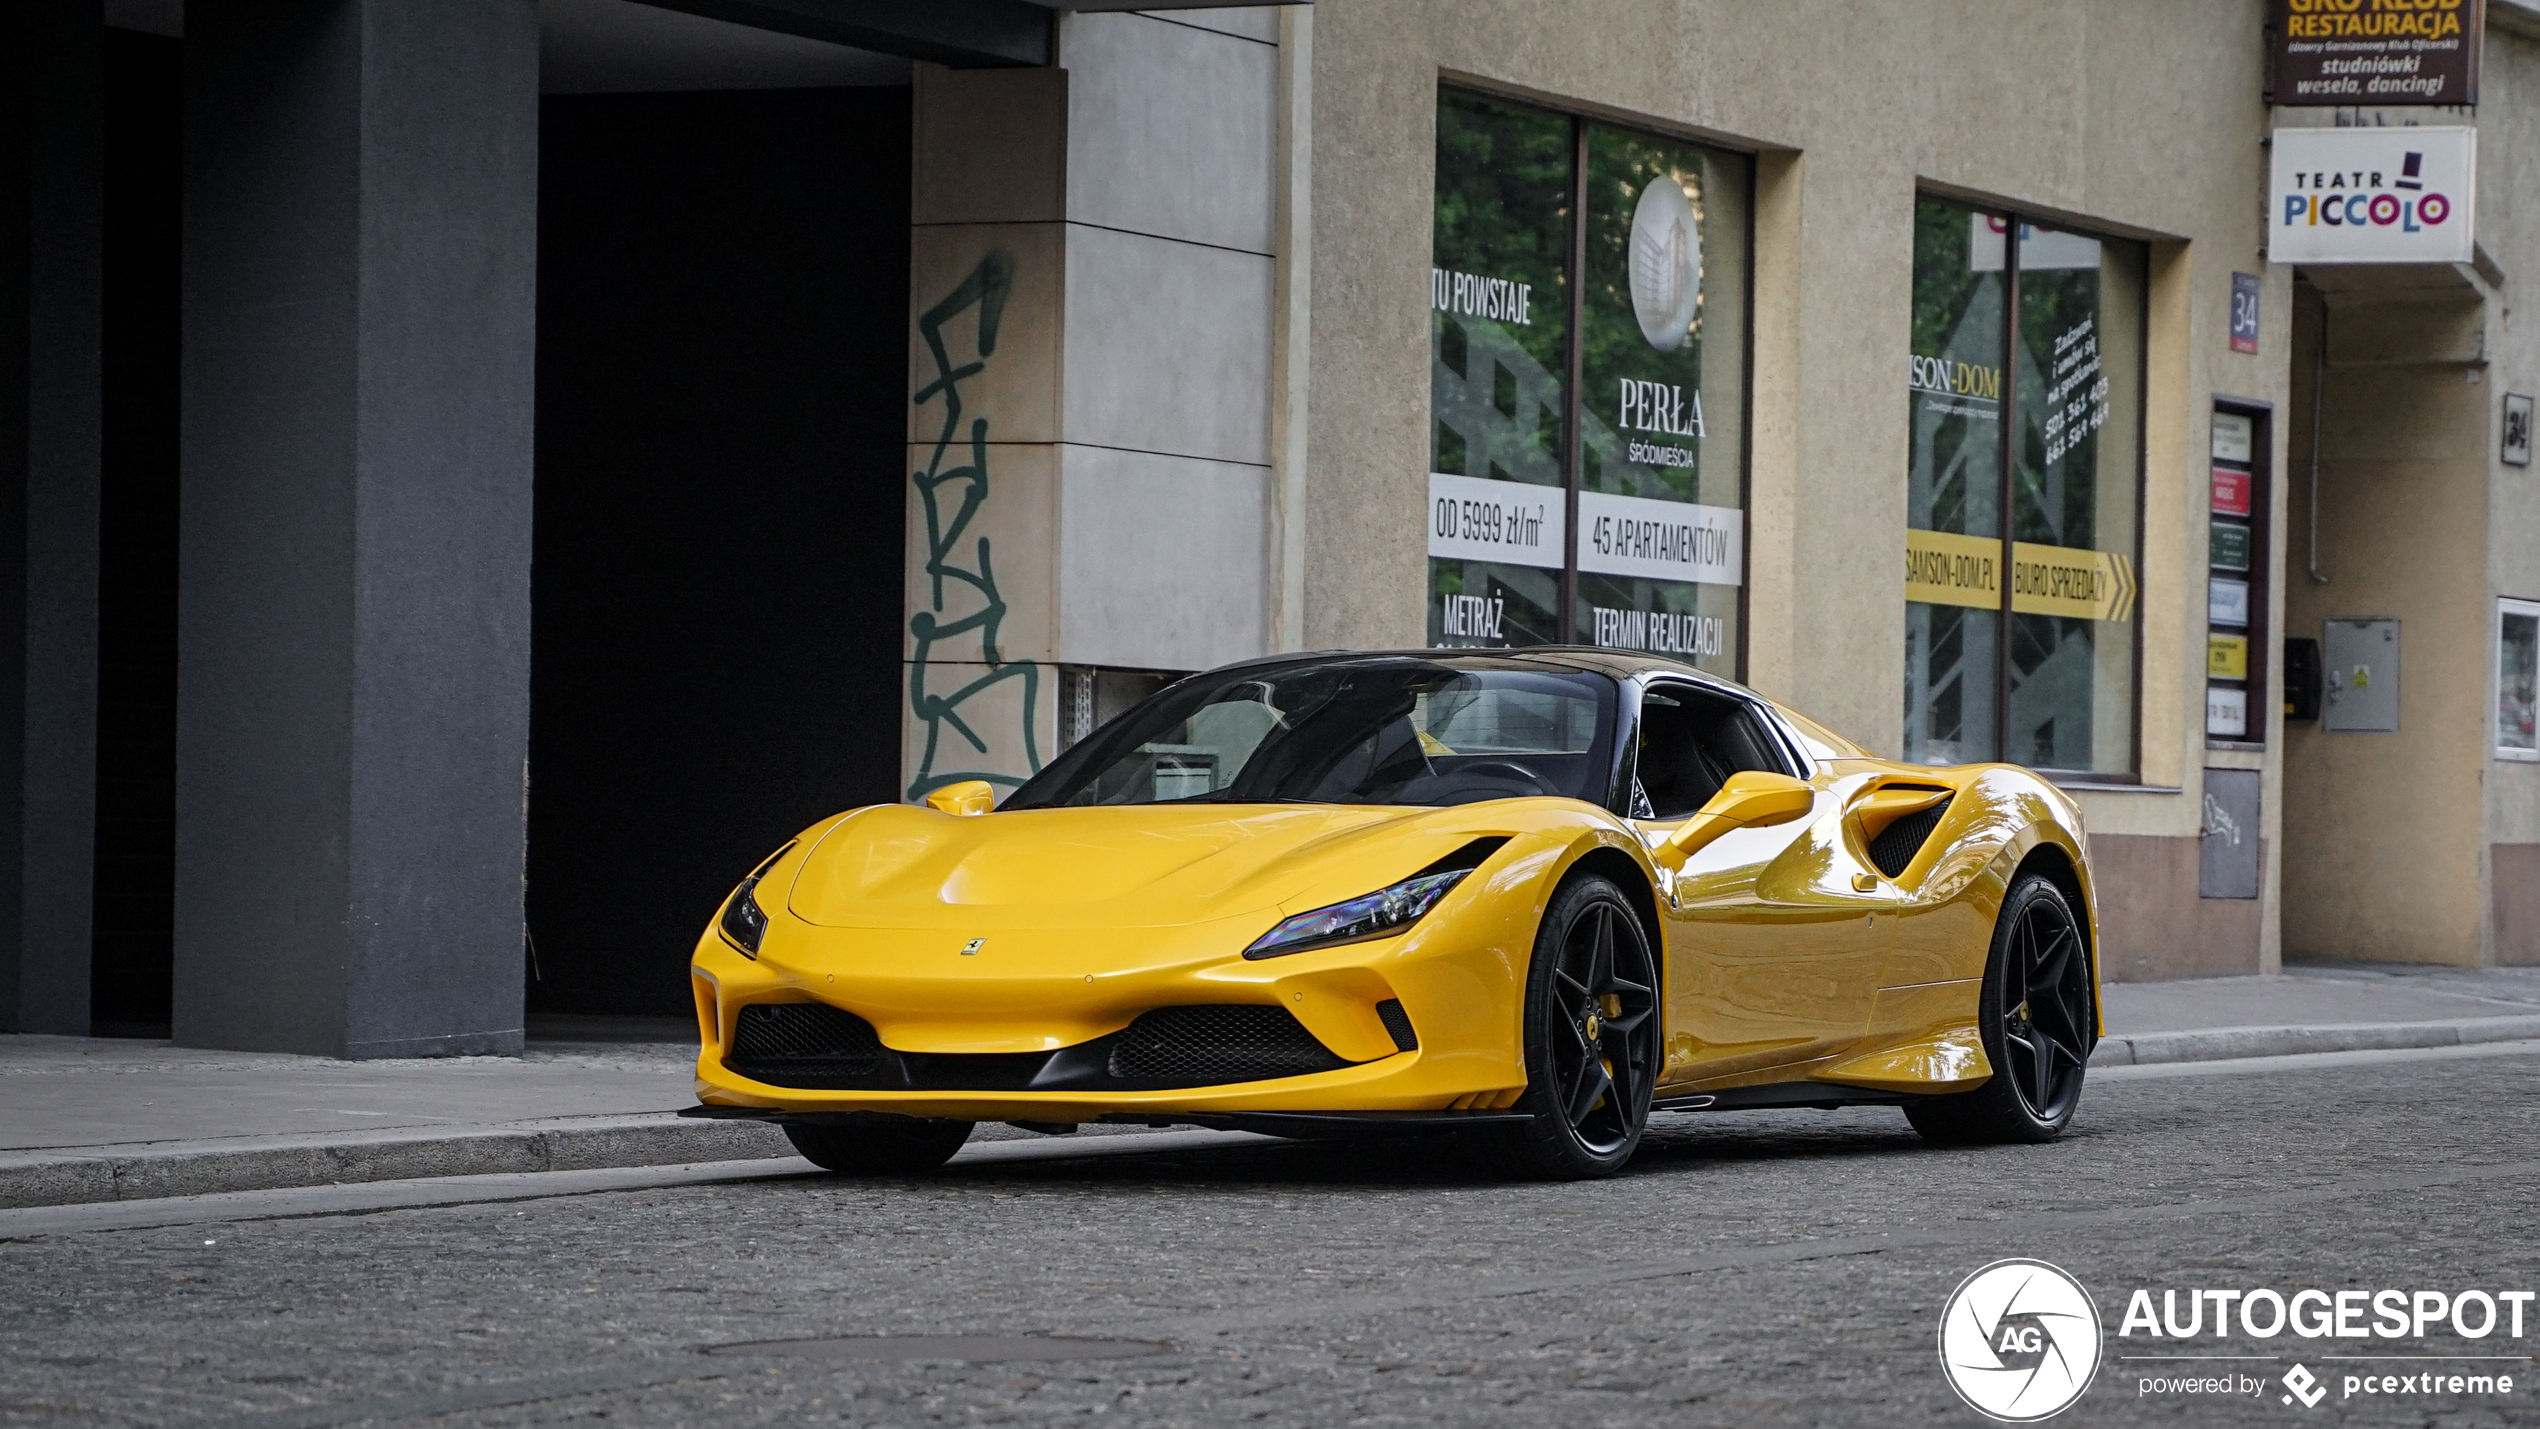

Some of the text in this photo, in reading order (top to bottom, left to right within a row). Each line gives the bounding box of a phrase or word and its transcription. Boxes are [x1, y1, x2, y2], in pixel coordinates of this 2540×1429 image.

[2288, 12, 2461, 39] RESTAURACJA
[2388, 39, 2410, 51] Klub
[2297, 74, 2445, 96] wesela, dancingi
[2321, 55, 2421, 74] studniówki
[2295, 172, 2383, 189] TEATR
[2284, 193, 2450, 233] PICCOLO
[1432, 268, 1531, 325] TU POWSTAJE
[2234, 292, 2256, 334] 34
[1620, 378, 1706, 438] PERŁA
[1629, 439, 1694, 468] ŚRÓDMIEŚCIA
[1437, 497, 1457, 539] OD
[1463, 500, 1502, 543] 5999
[1593, 516, 1728, 567] 45 APARTAMENTÓW
[1906, 549, 1995, 591] SAMSON-DOM.PL
[2015, 562, 2107, 602] BIURO SPRZEDAŻY
[1444, 588, 1504, 639] METRAŻ
[1593, 606, 1723, 656] TERMIN REALIZACJI
